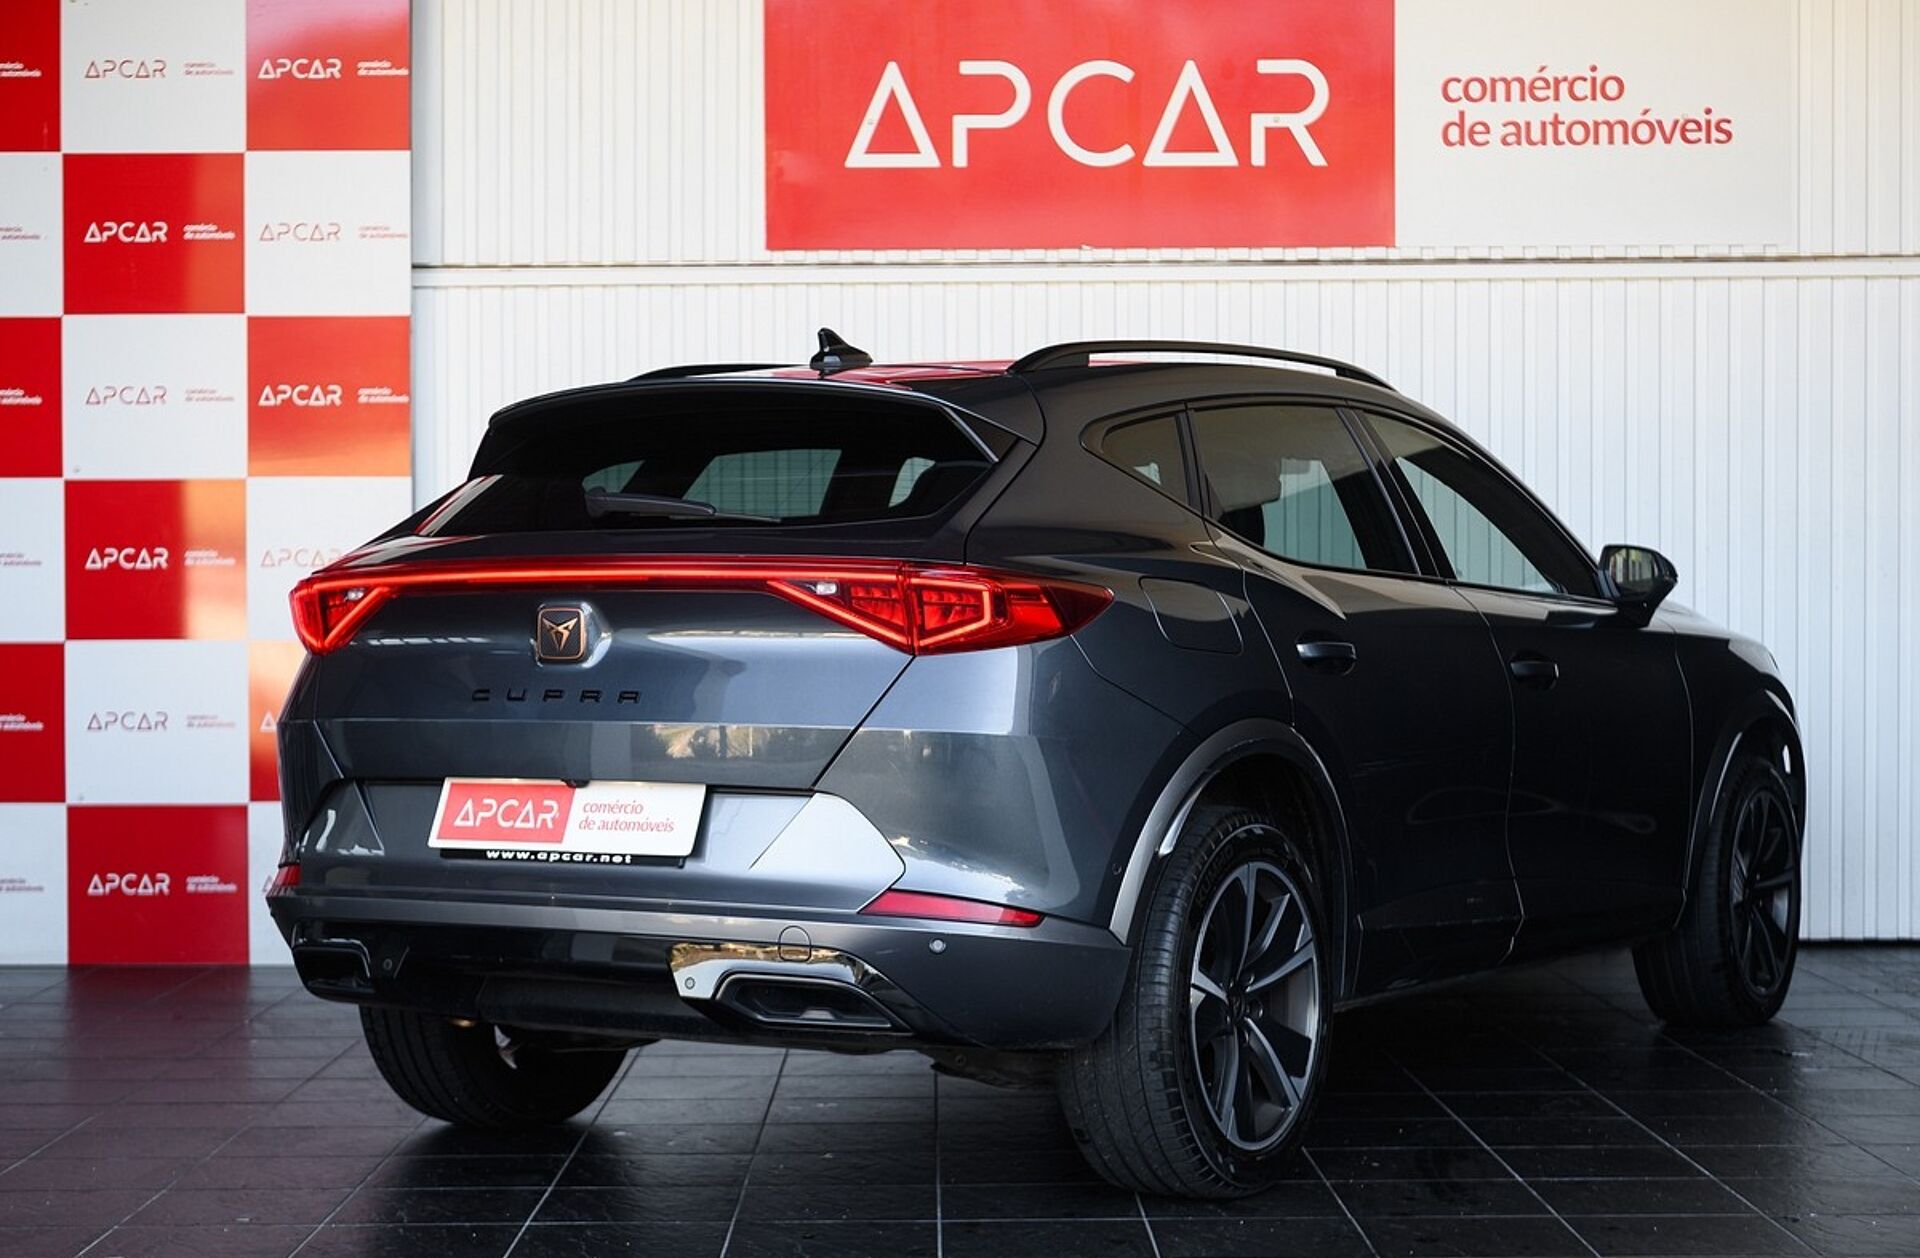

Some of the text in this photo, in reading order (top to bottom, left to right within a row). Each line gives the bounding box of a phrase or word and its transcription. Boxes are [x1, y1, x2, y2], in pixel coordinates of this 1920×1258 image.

[84, 59, 167, 79] APCAR
[258, 58, 342, 79] APCAR
[1441, 65, 1625, 103] comércio
[844, 58, 1330, 169] APCAR
[1441, 108, 1733, 147] de automóveis
[84, 222, 168, 243] APCAR
[259, 222, 341, 242] APCAR
[86, 386, 167, 405] APCAR
[258, 385, 342, 406] APCAR
[85, 547, 169, 570] APCAR
[471, 688, 641, 704] CUPRA
[87, 711, 168, 731] APCAR
[453, 798, 559, 829] APCAR
[583, 799, 644, 815] comércio
[578, 816, 675, 833] de automóveis
[486, 850, 632, 864] www.apcar.net
[87, 873, 170, 896] APCAR
